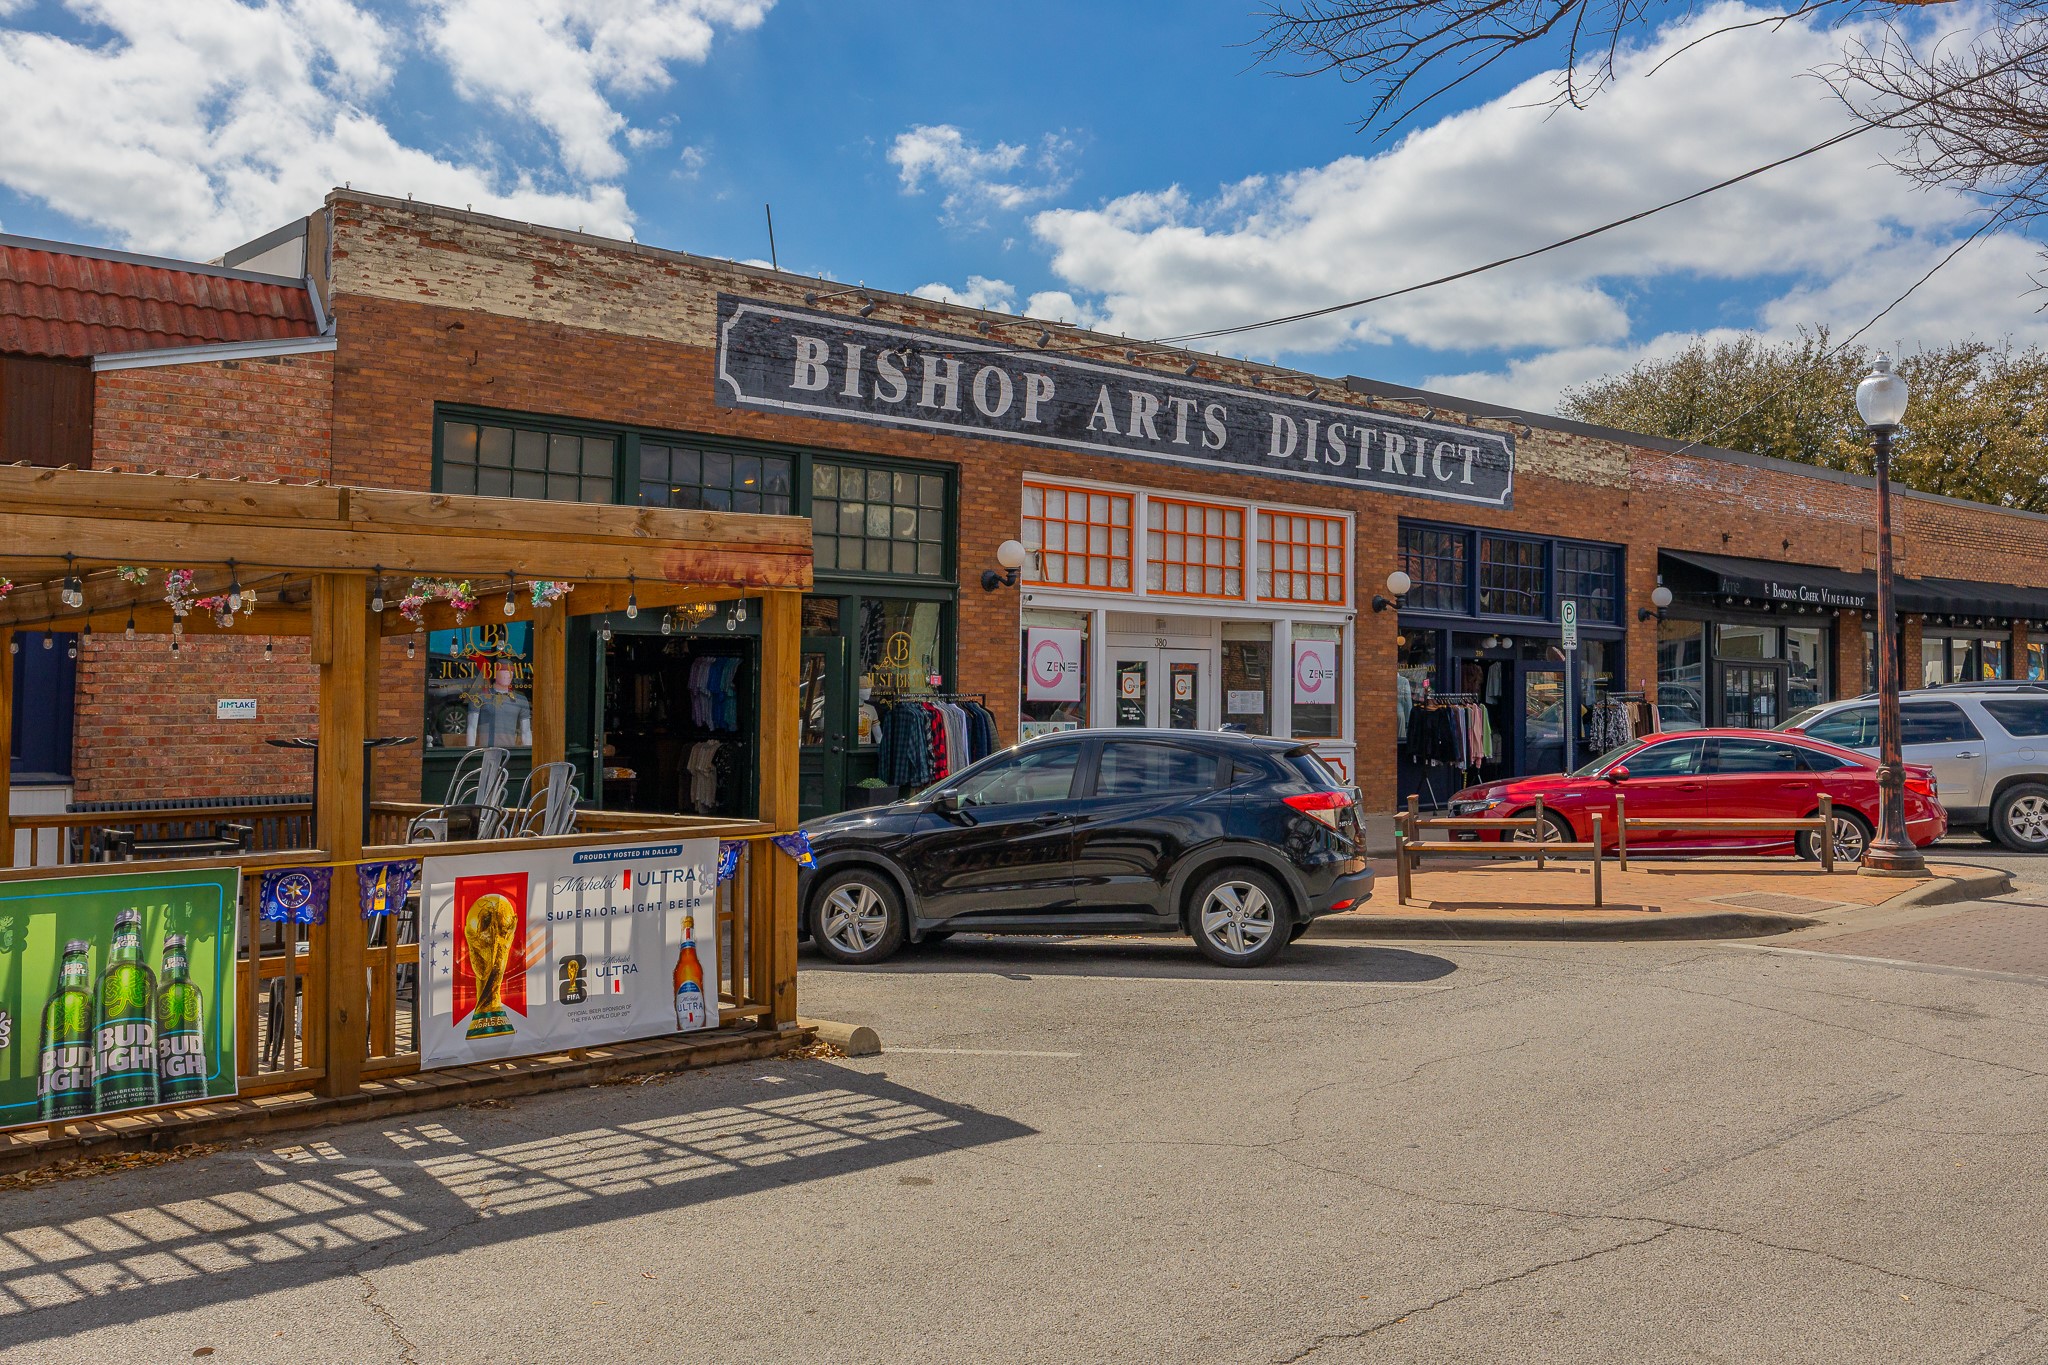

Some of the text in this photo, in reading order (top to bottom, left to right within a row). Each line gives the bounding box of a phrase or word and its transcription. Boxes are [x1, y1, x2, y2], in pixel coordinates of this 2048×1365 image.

[788, 334, 1480, 485] BISHOP ARTS DISTRICT
[1799, 586, 1819, 602] CREEK
[1821, 588, 1865, 607] VINEYARDS
[1154, 638, 1167, 647] 380
[894, 639, 909, 660] B
[439, 662, 477, 680] JUST
[1047, 662, 1066, 672] ZEN
[1309, 670, 1324, 679] ZEN
[579, 853, 611, 861] PROUDLY
[614, 851, 640, 859] HOSTED
[652, 848, 677, 856] DALLAS
[552, 868, 696, 895] Michelob ULTRA
[547, 898, 701, 922] SUPERIOR LIGHT BEER
[117, 934, 137, 942] BUD
[114, 941, 140, 949] LIGHT
[164, 962, 188, 970] LIGHT
[167, 956, 185, 964] BUD
[600, 955, 631, 966] Michelob
[596, 963, 638, 978] ULTRA
[678, 1001, 703, 1013] ULTRA
[474, 1021, 495, 1029] WORLD
[98, 1024, 153, 1052] BUD
[159, 1035, 202, 1058] BUD
[42, 1047, 92, 1073] BUD
[37, 1068, 92, 1096] LIGH
[106, 1093, 128, 1101] SIMPLE
